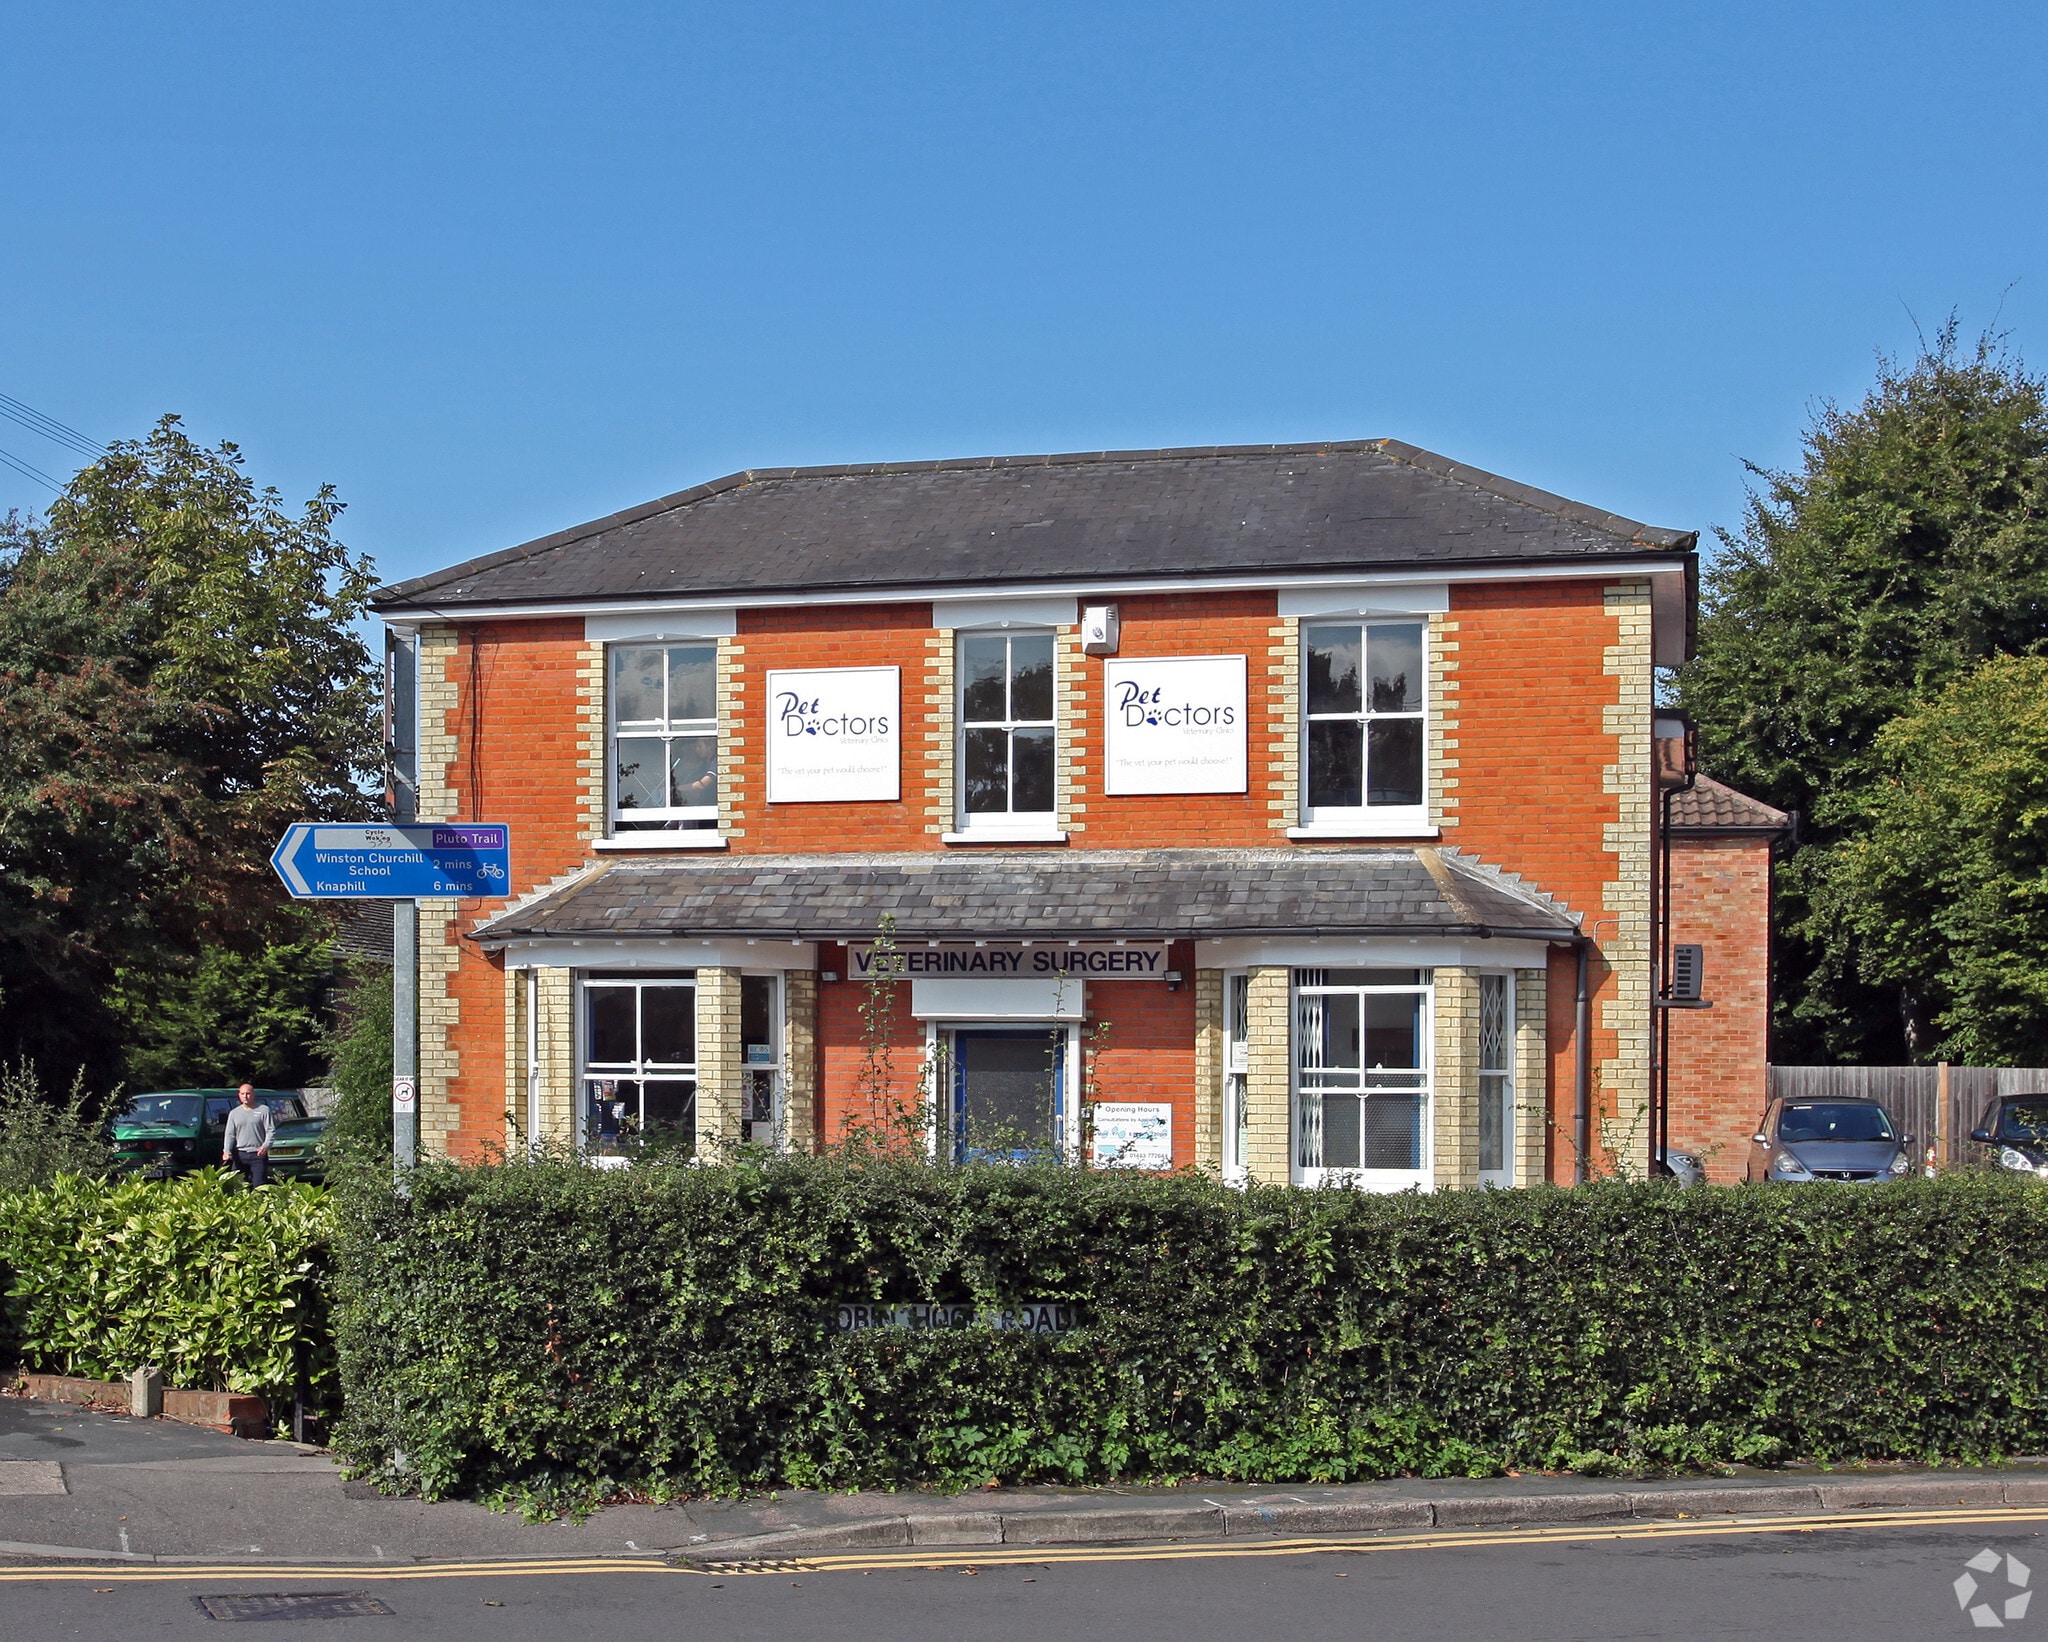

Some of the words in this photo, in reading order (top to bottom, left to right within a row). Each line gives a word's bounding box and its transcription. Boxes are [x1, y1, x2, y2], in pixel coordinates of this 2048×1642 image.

[1115, 681, 1160, 711] Pet
[776, 692, 819, 721] Pet
[1134, 759, 1145, 767] vet
[1147, 760, 1162, 768] your
[1164, 758, 1176, 767] pet
[1178, 756, 1198, 765] would
[807, 768, 821, 776] your
[823, 767, 834, 775] pet
[836, 765, 855, 773] would
[435, 833, 468, 844] Pluto
[472, 833, 498, 844] Trail
[316, 853, 364, 863] Winston
[369, 853, 424, 863] Churchill
[433, 859, 440, 869] 2
[444, 860, 472, 869] mins
[349, 866, 391, 876] School
[316, 881, 366, 893] Knaphill
[433, 881, 441, 891] 6
[445, 881, 473, 891] mins
[855, 952, 1023, 972] VETERINARY
[1033, 951, 1160, 972] SURGERY
[1105, 1106, 1136, 1114] Opening
[1002, 1306, 1071, 1332] ROAD
